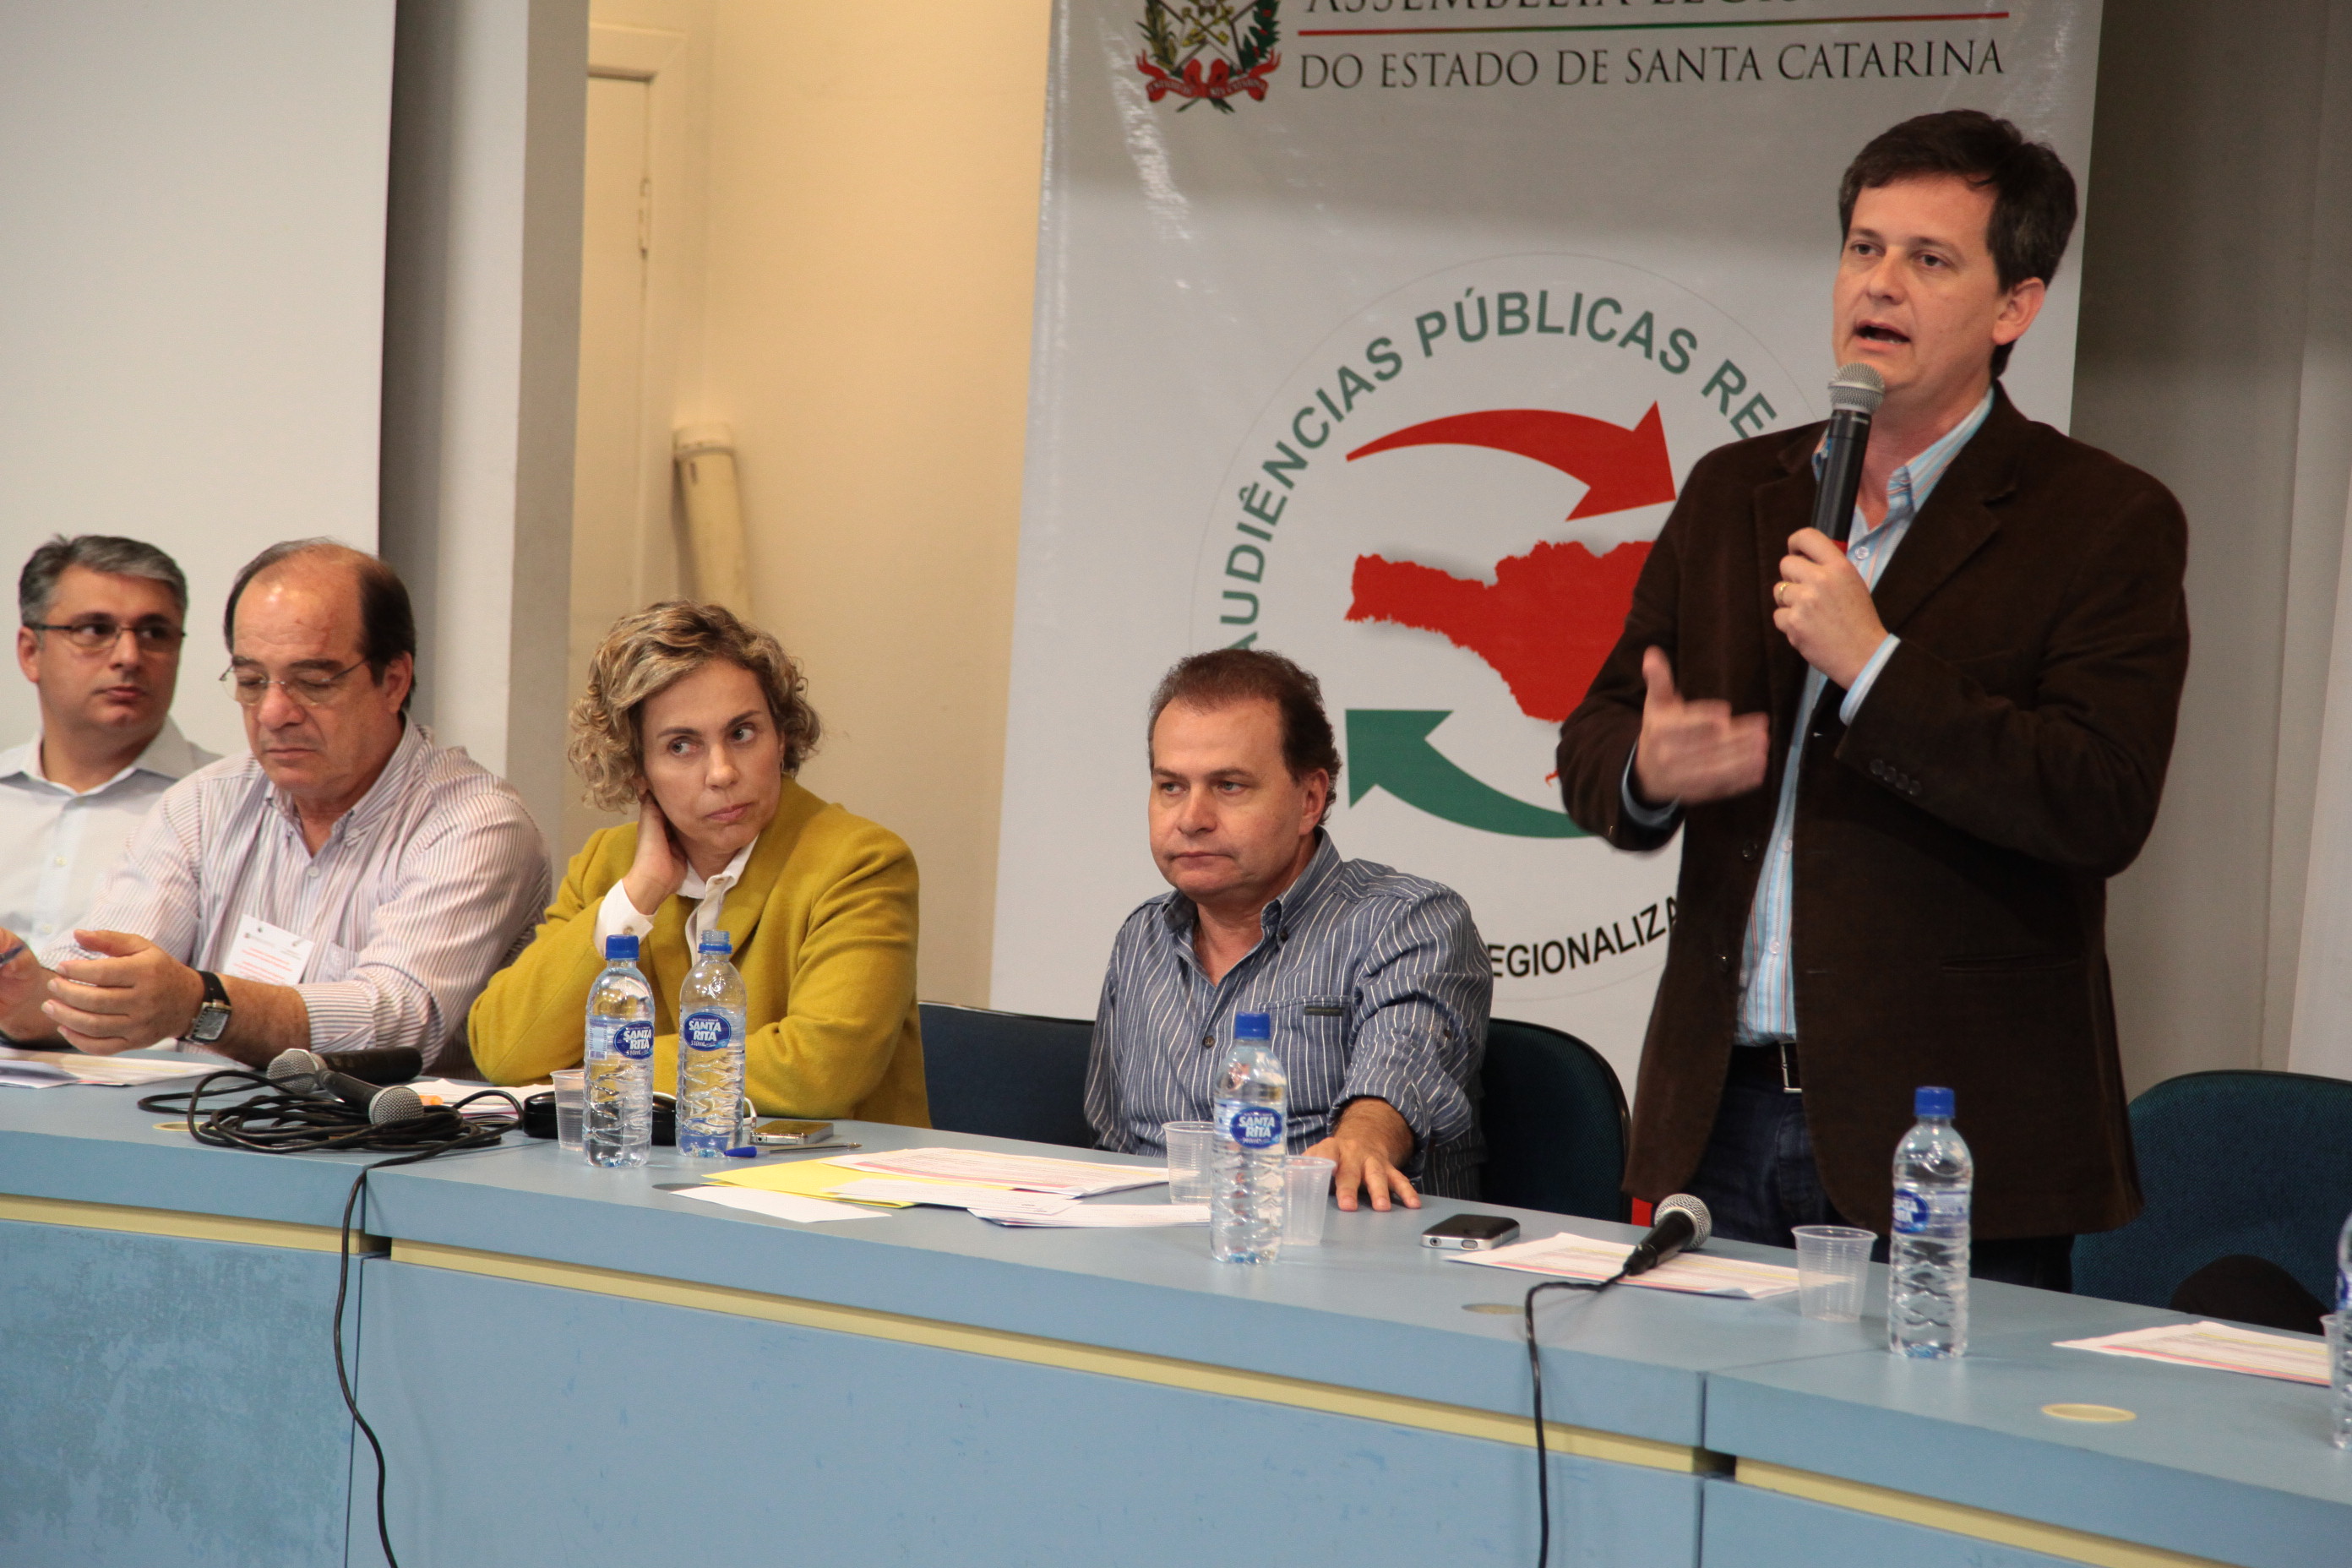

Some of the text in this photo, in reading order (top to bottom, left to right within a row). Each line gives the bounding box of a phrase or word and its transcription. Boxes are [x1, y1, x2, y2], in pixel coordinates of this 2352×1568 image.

[1299, 53, 1364, 89] DO
[1380, 50, 1538, 88] ESTADO
[1556, 48, 1609, 85] DE
[1624, 46, 1763, 84] SANTA
[1777, 39, 2005, 81] CATARINA
[1415, 286, 1698, 374] PÚBLICAS
[688, 1021, 722, 1032] SANTA
[623, 1029, 652, 1041] SANTA
[693, 1030, 717, 1042] RITA
[629, 1038, 650, 1050] RITA
[1239, 1116, 1276, 1128] SANTA
[1244, 1125, 1272, 1138] RITA
